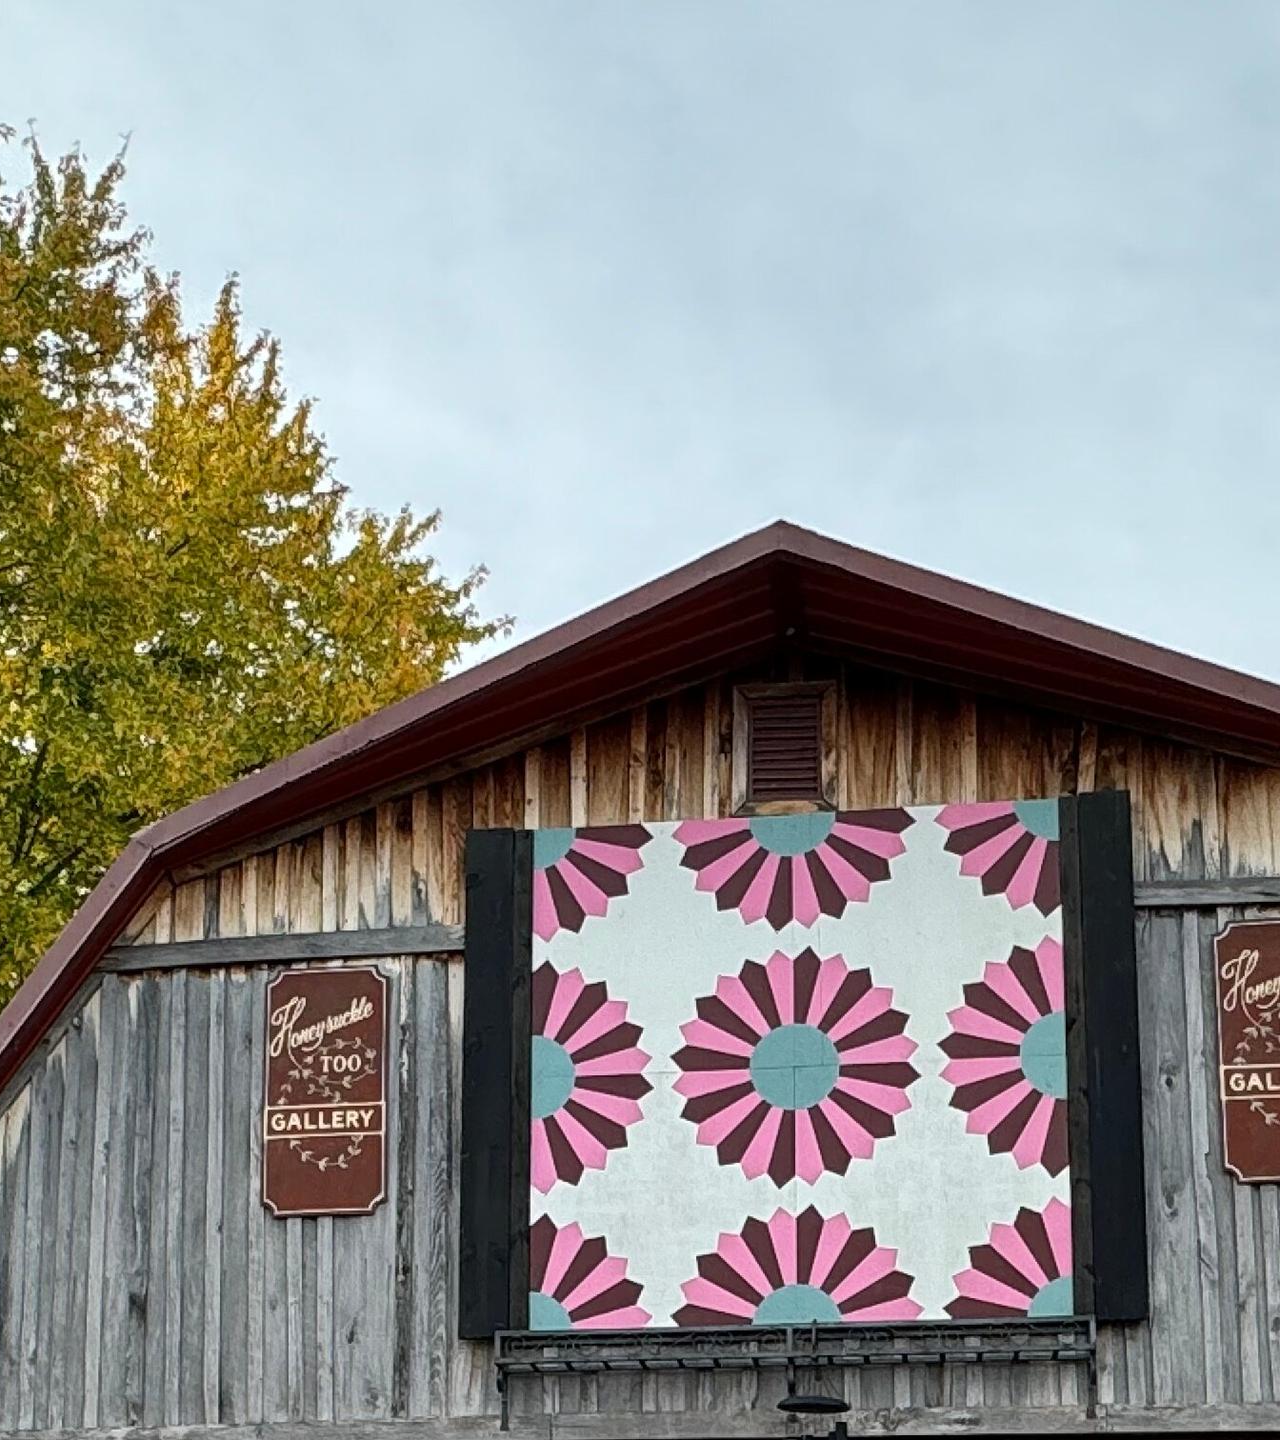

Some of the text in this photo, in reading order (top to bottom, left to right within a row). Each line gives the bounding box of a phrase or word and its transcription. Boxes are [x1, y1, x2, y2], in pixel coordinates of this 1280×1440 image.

[270, 996, 374, 1058] Honeysuckle
[320, 1054, 362, 1073] TOO
[271, 1109, 375, 1132] GALLERY
